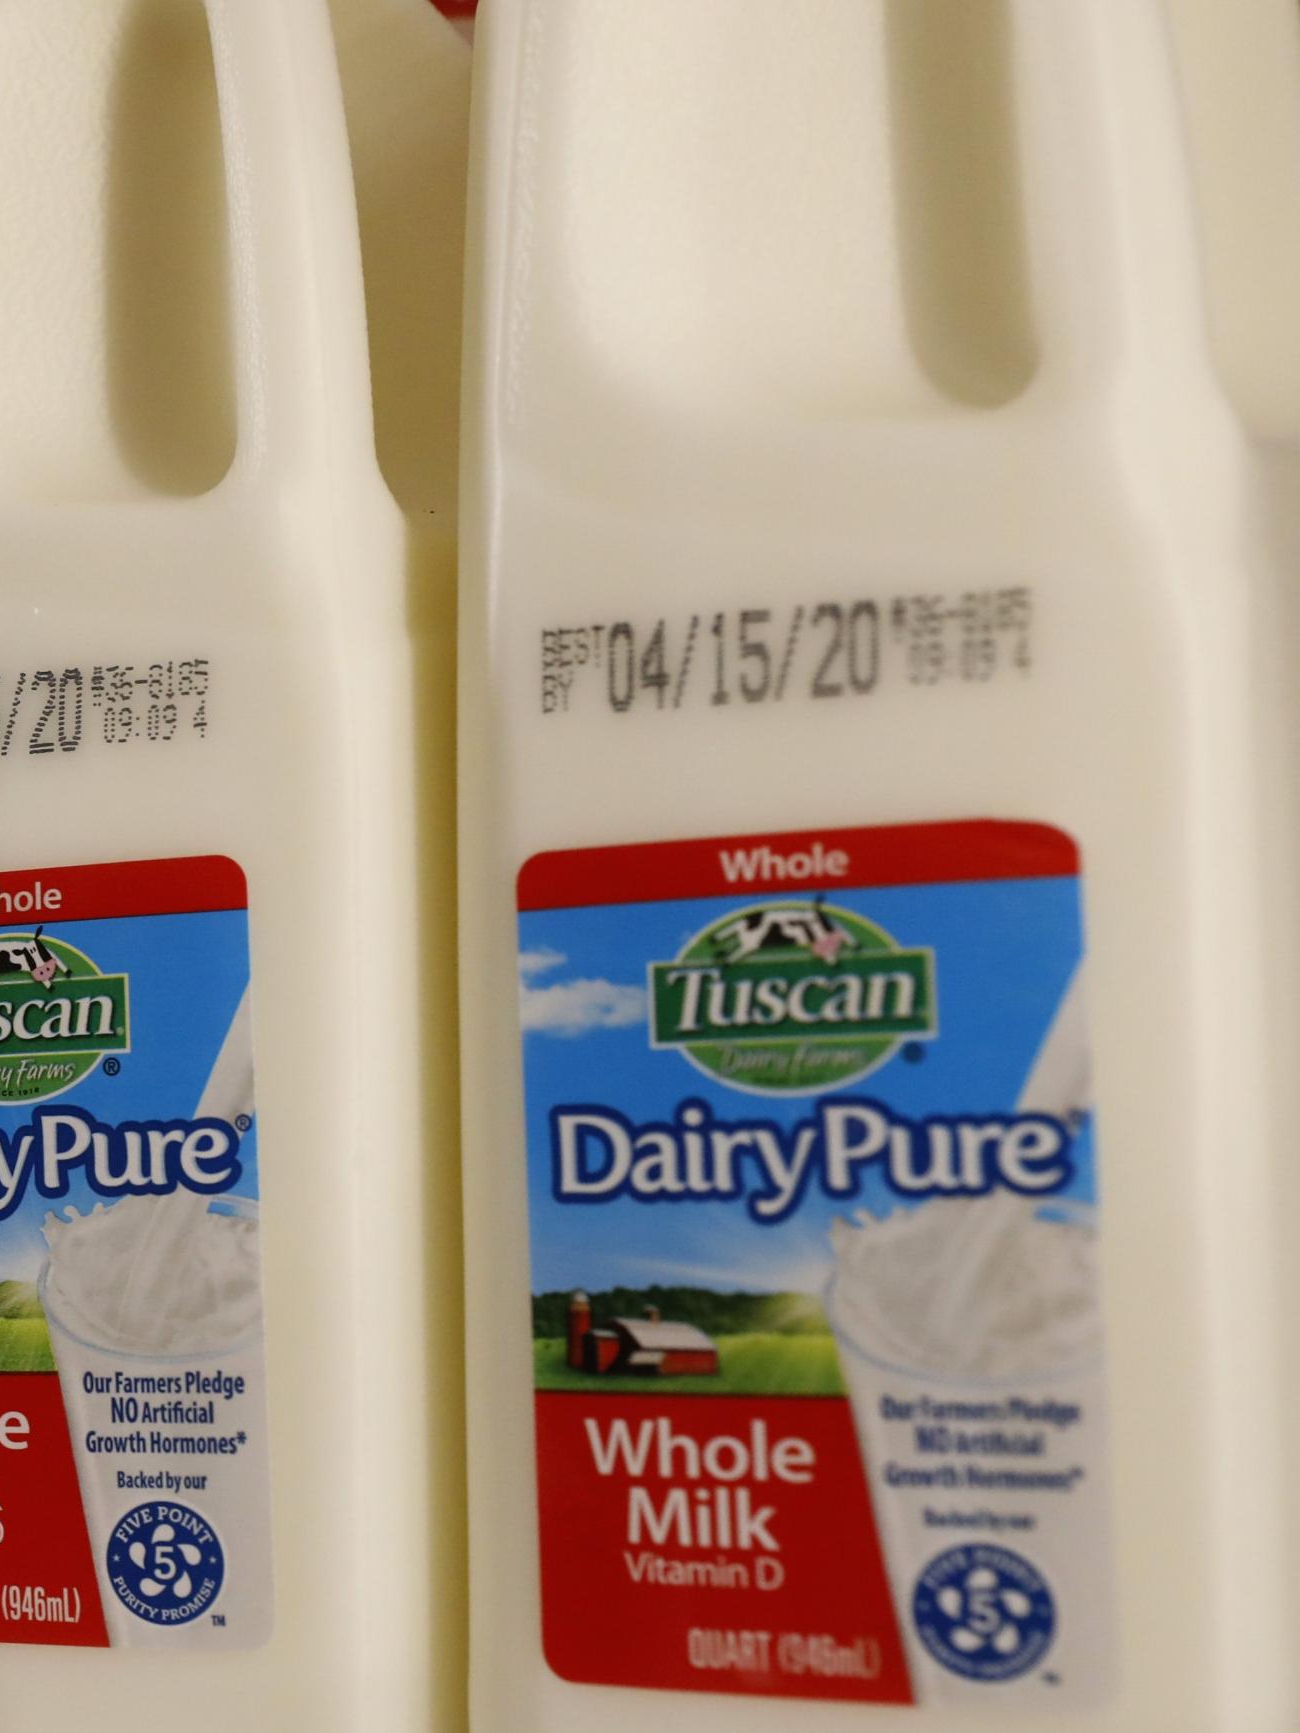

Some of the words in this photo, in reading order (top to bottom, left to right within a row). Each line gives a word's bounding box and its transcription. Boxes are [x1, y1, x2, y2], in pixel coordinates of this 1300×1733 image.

[607, 599, 880, 712] 04/15/20
[102, 703, 178, 744] 09:09
[192, 700, 208, 739] 4
[719, 841, 850, 884] Whole
[665, 966, 916, 1034] Tuscan
[15, 1058, 78, 1086] Farms
[552, 1099, 1070, 1220] DairyPure
[82, 1370, 112, 1394] Our
[114, 1370, 182, 1394] Farmers
[184, 1369, 245, 1400] Pledge
[110, 1396, 139, 1424] NO
[141, 1400, 215, 1424] Artificial
[85, 1430, 147, 1454] Growth
[584, 1416, 815, 1484] Whole
[116, 1470, 164, 1489] Backed
[165, 1470, 183, 1494] by
[183, 1475, 208, 1490] our
[115, 1508, 153, 1544] FIVE
[157, 1506, 214, 1545] POINT
[626, 1486, 781, 1552] Milk
[153, 1545, 177, 1581] 5
[623, 1549, 750, 1591] Vitamin
[755, 1555, 786, 1592] D
[1, 1586, 81, 1623] (946mL)
[113, 1576, 159, 1620] PURITY
[161, 1577, 216, 1622] PROMISE
